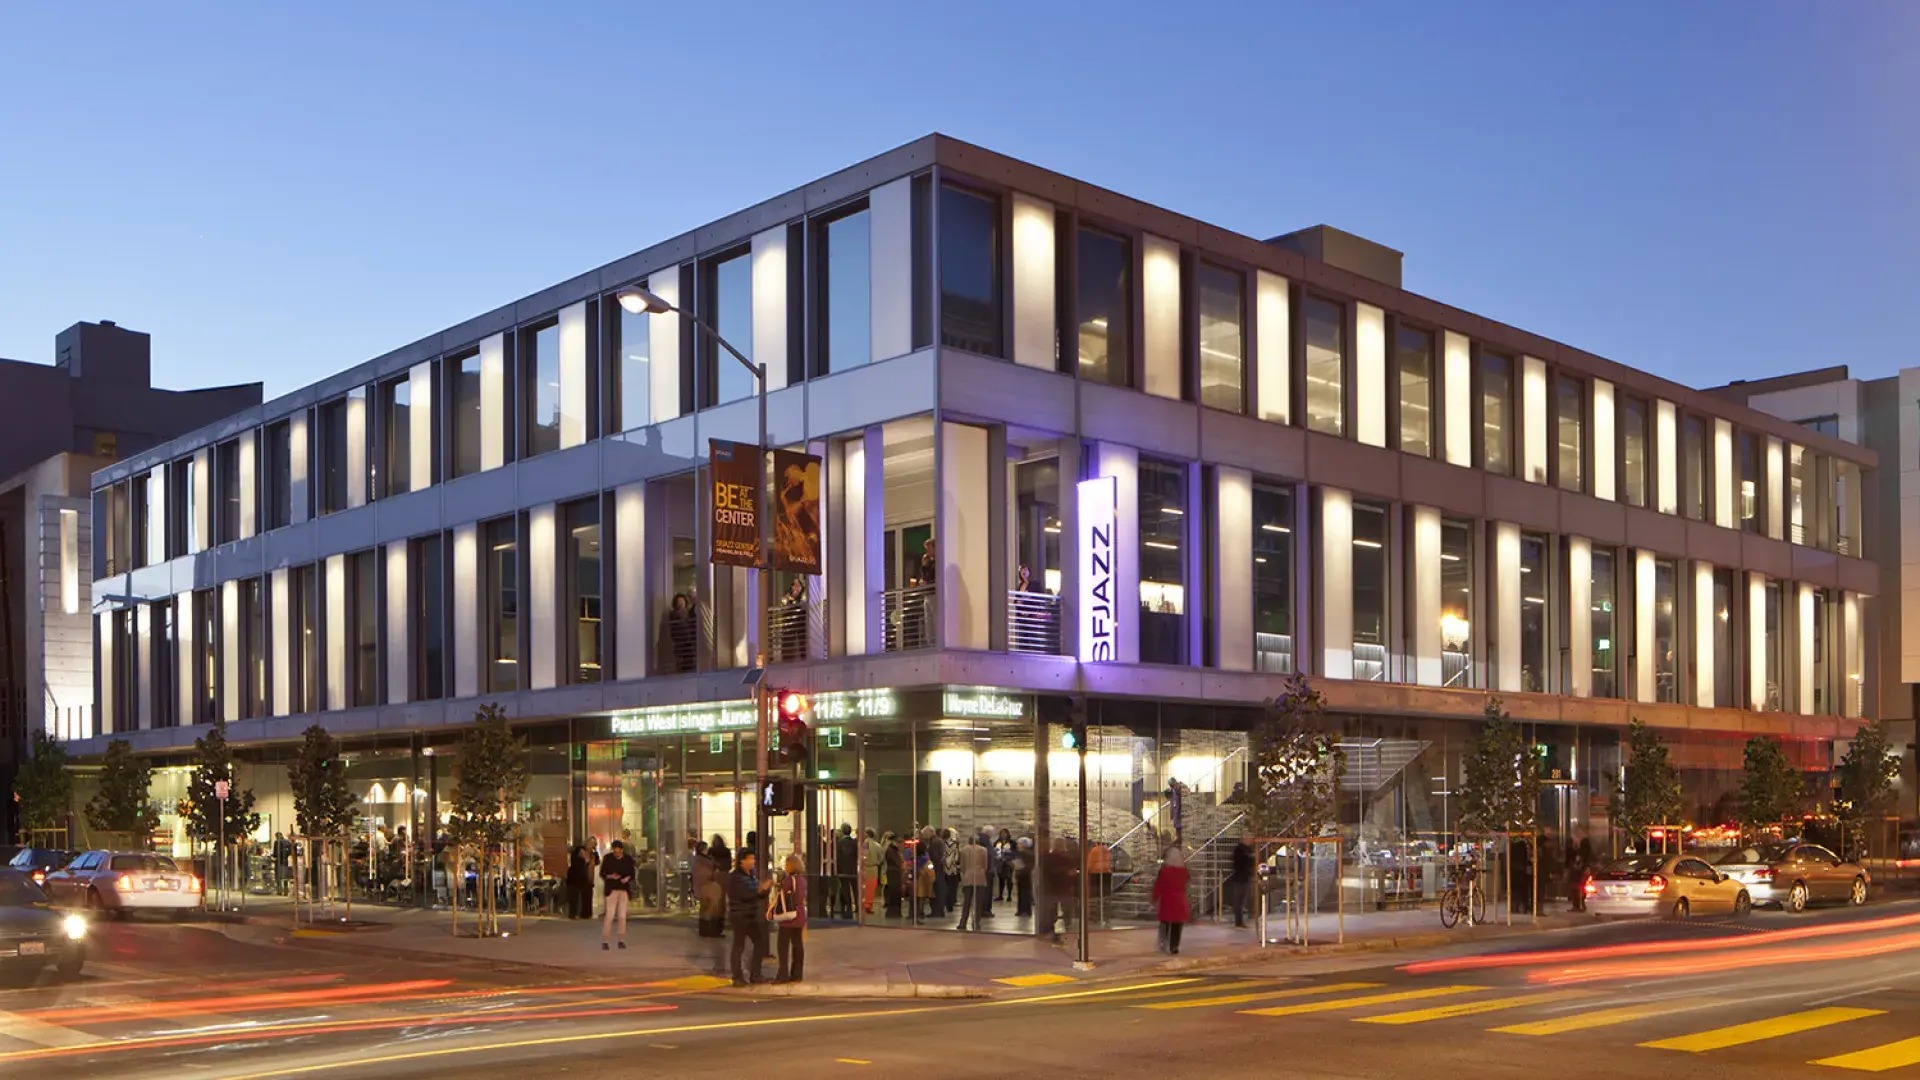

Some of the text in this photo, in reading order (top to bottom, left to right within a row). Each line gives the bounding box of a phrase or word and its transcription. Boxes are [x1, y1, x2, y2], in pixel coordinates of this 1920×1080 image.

[716, 482, 739, 508] BE
[740, 499, 754, 509] THE
[716, 509, 754, 527] CENTER
[1092, 523, 1111, 662] SFJAZZ
[611, 716, 644, 733] Paula
[647, 713, 677, 730] West
[680, 712, 714, 731] sings
[718, 709, 751, 725] June
[813, 701, 844, 719] 11/6
[857, 697, 889, 716] 11/9
[948, 693, 978, 715] Wayne
